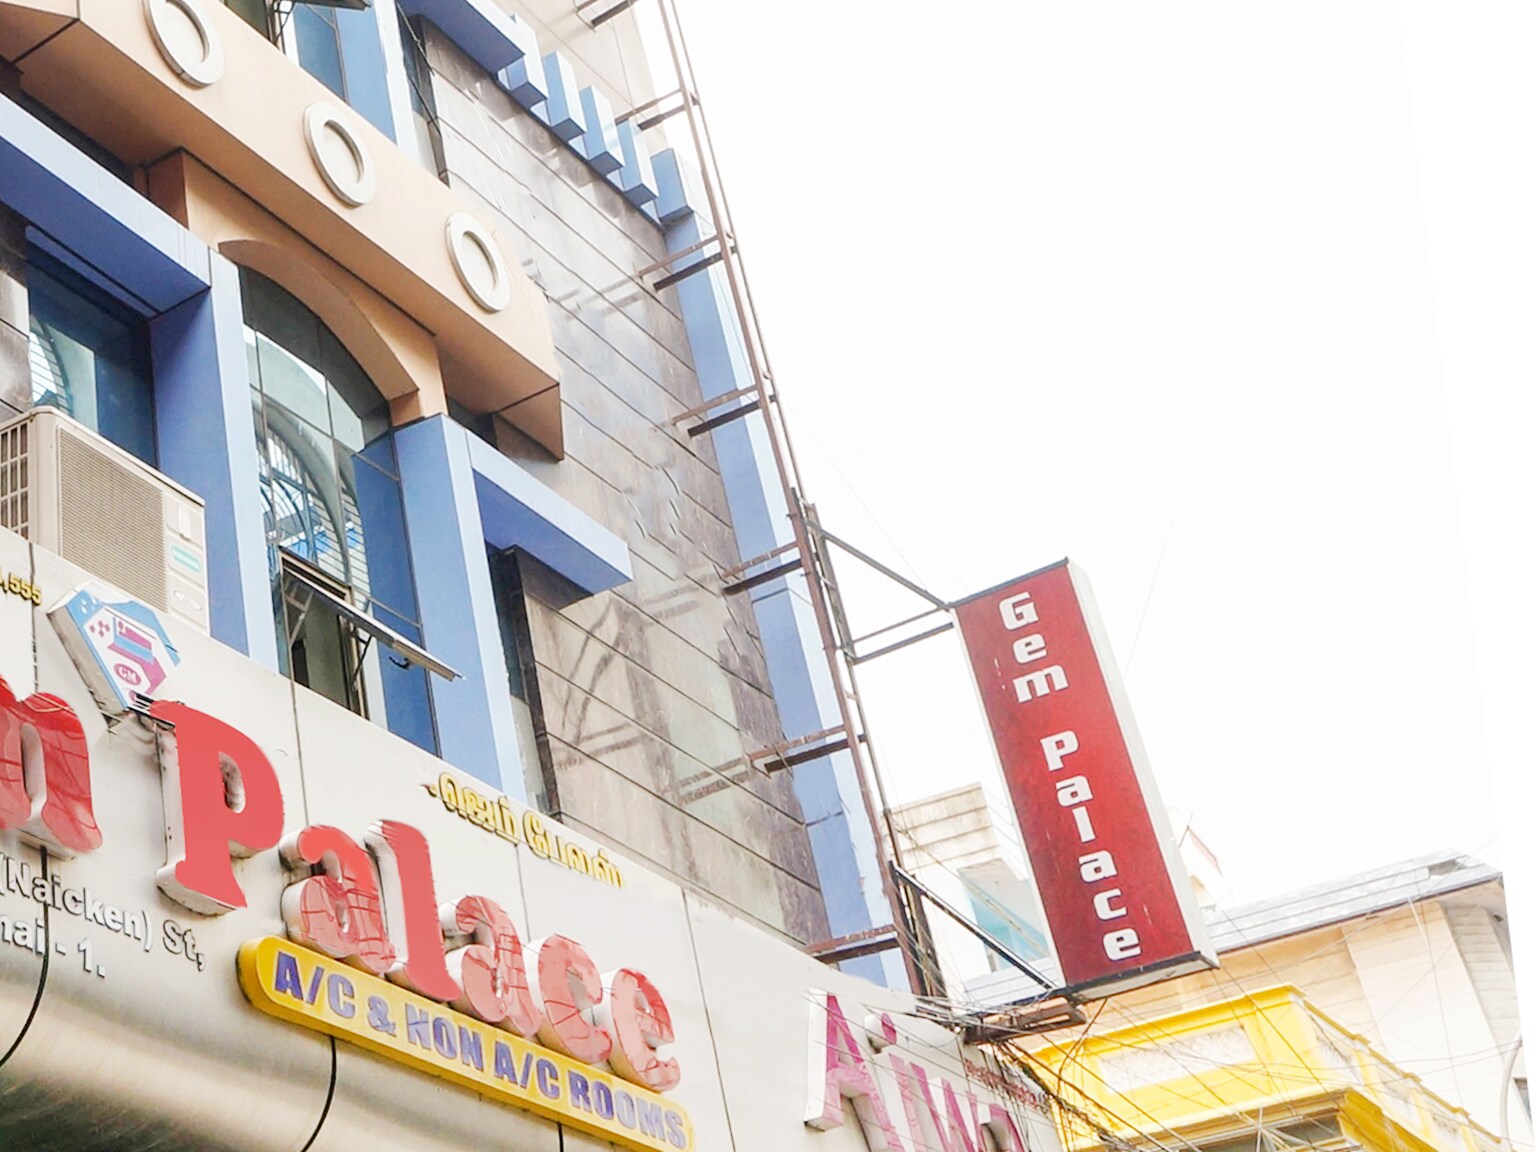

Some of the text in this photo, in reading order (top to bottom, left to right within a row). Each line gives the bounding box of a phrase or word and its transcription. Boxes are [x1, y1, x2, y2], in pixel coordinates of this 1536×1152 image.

[156, 699, 681, 1091] Palace
[998, 591, 1141, 961] Gem Palace
[162, 919, 206, 971] St,
[274, 951, 686, 1150] A/C & NON A/C ROOMS
